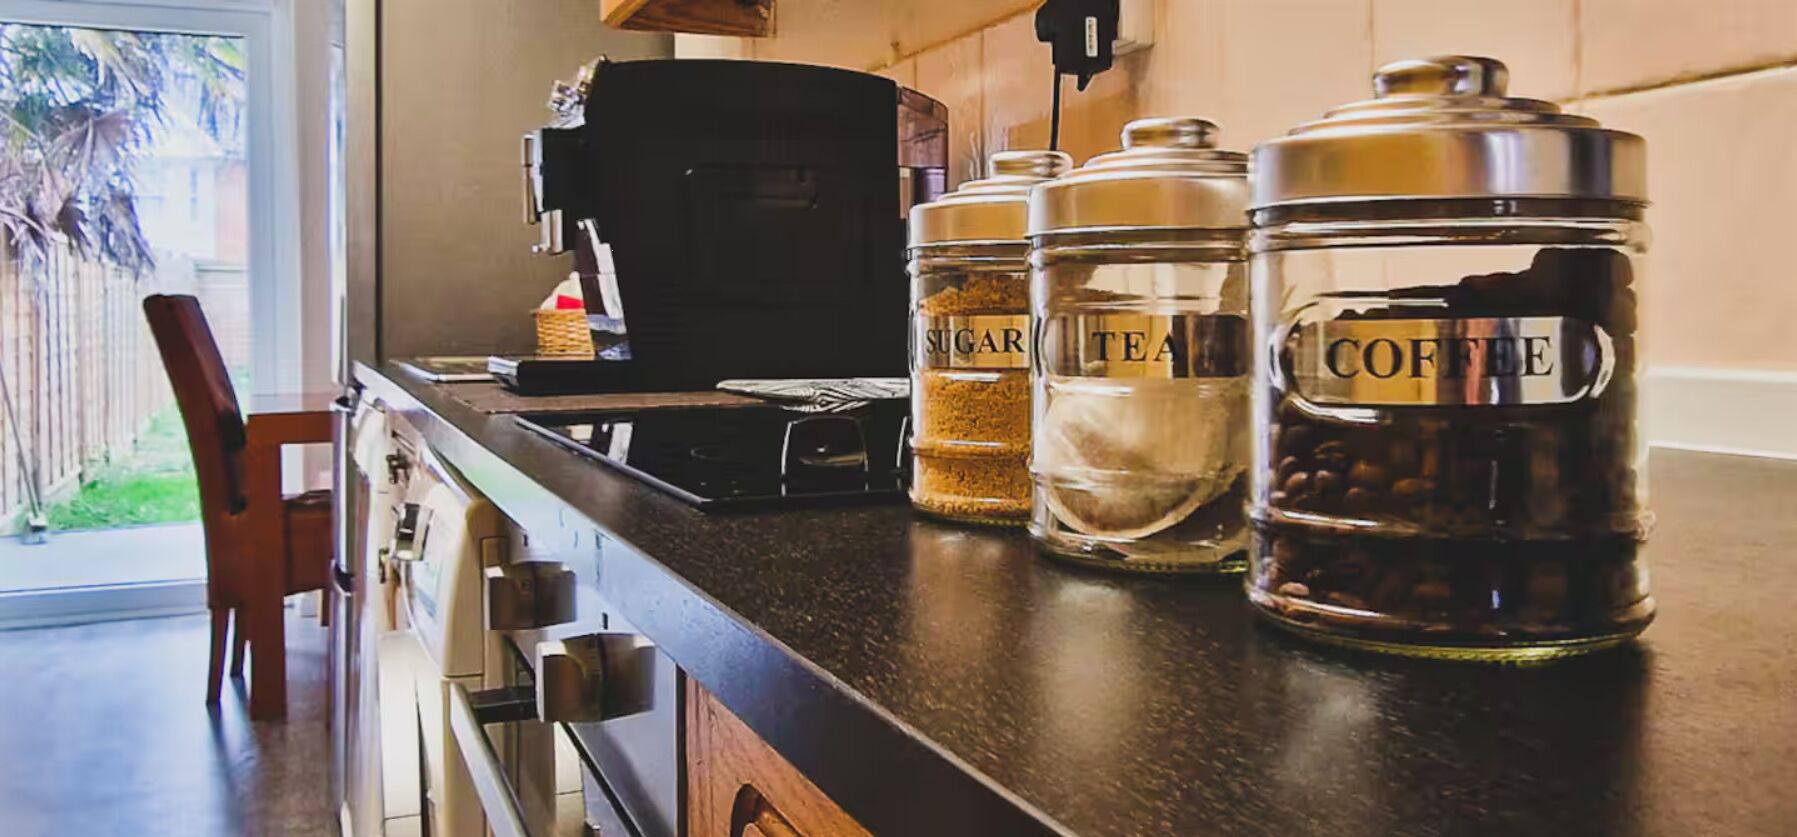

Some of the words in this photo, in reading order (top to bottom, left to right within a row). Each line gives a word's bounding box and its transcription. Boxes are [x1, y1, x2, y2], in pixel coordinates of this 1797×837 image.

[926, 328, 1025, 354] SUGAR
[1092, 331, 1181, 362] TEA
[1326, 336, 1554, 379] COFFEE
